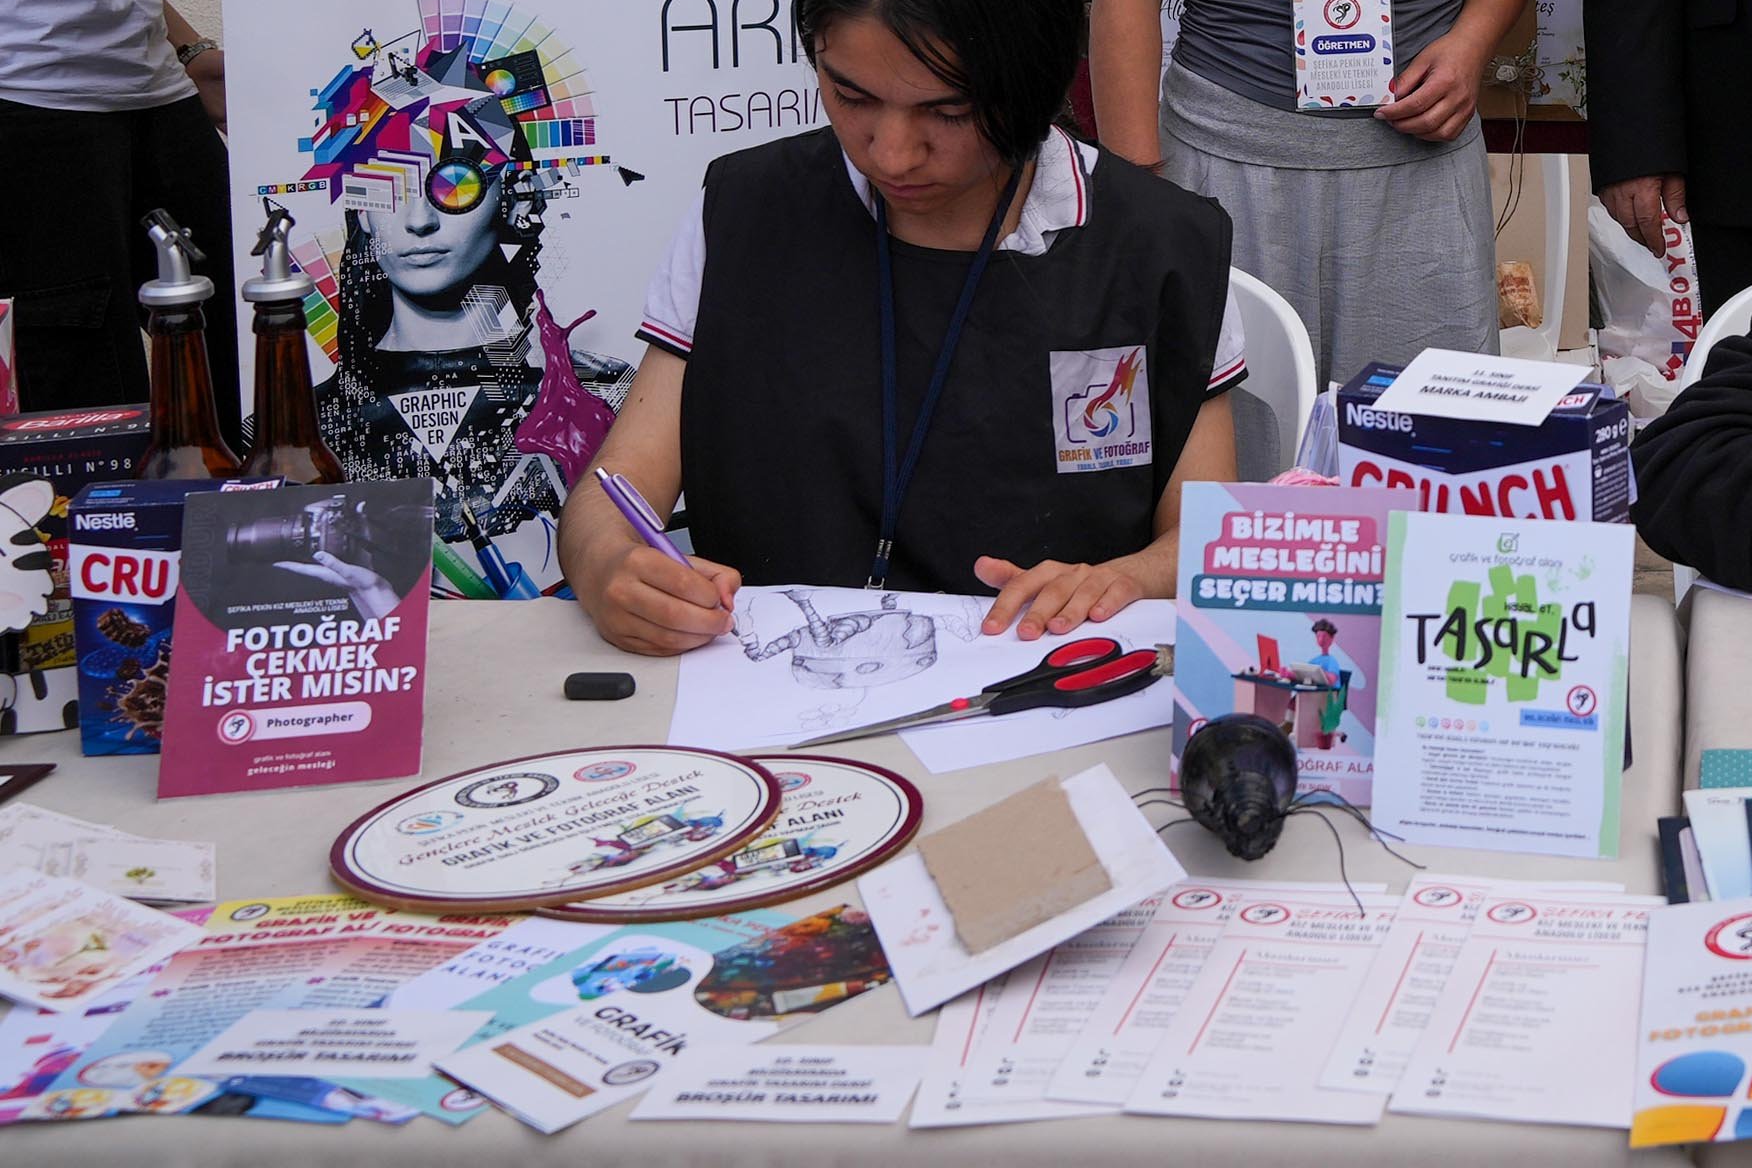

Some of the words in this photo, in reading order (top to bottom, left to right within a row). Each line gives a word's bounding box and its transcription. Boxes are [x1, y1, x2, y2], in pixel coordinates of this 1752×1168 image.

[1317, 39, 1371, 51] ÖĞRETMEN
[400, 391, 467, 414] GRAPHIC
[1419, 384, 1471, 398] MARKA
[412, 411, 459, 430] DESIGN
[428, 429, 445, 445] ER
[1058, 446, 1092, 462] GRAFİK
[1093, 447, 1104, 460] VE
[1104, 440, 1151, 458] FOTOĞRAF
[1231, 510, 1360, 543] BİZİMLE
[1213, 542, 1382, 574] MESLEĞİNİ
[81, 553, 170, 599] CRU
[1199, 576, 1288, 607] SEÇER
[226, 614, 401, 653] FOTOĞRAF
[246, 643, 379, 679] ÇEKMEK
[202, 675, 292, 707] İSTER
[301, 666, 418, 699] MİSİN?
[266, 712, 354, 728] Photographer
[441, 840, 511, 867] GRAFİK
[514, 831, 541, 845] VE
[646, 784, 700, 806] ALANI
[786, 808, 844, 827] ALANI
[593, 1004, 691, 1060] GRAFİK
